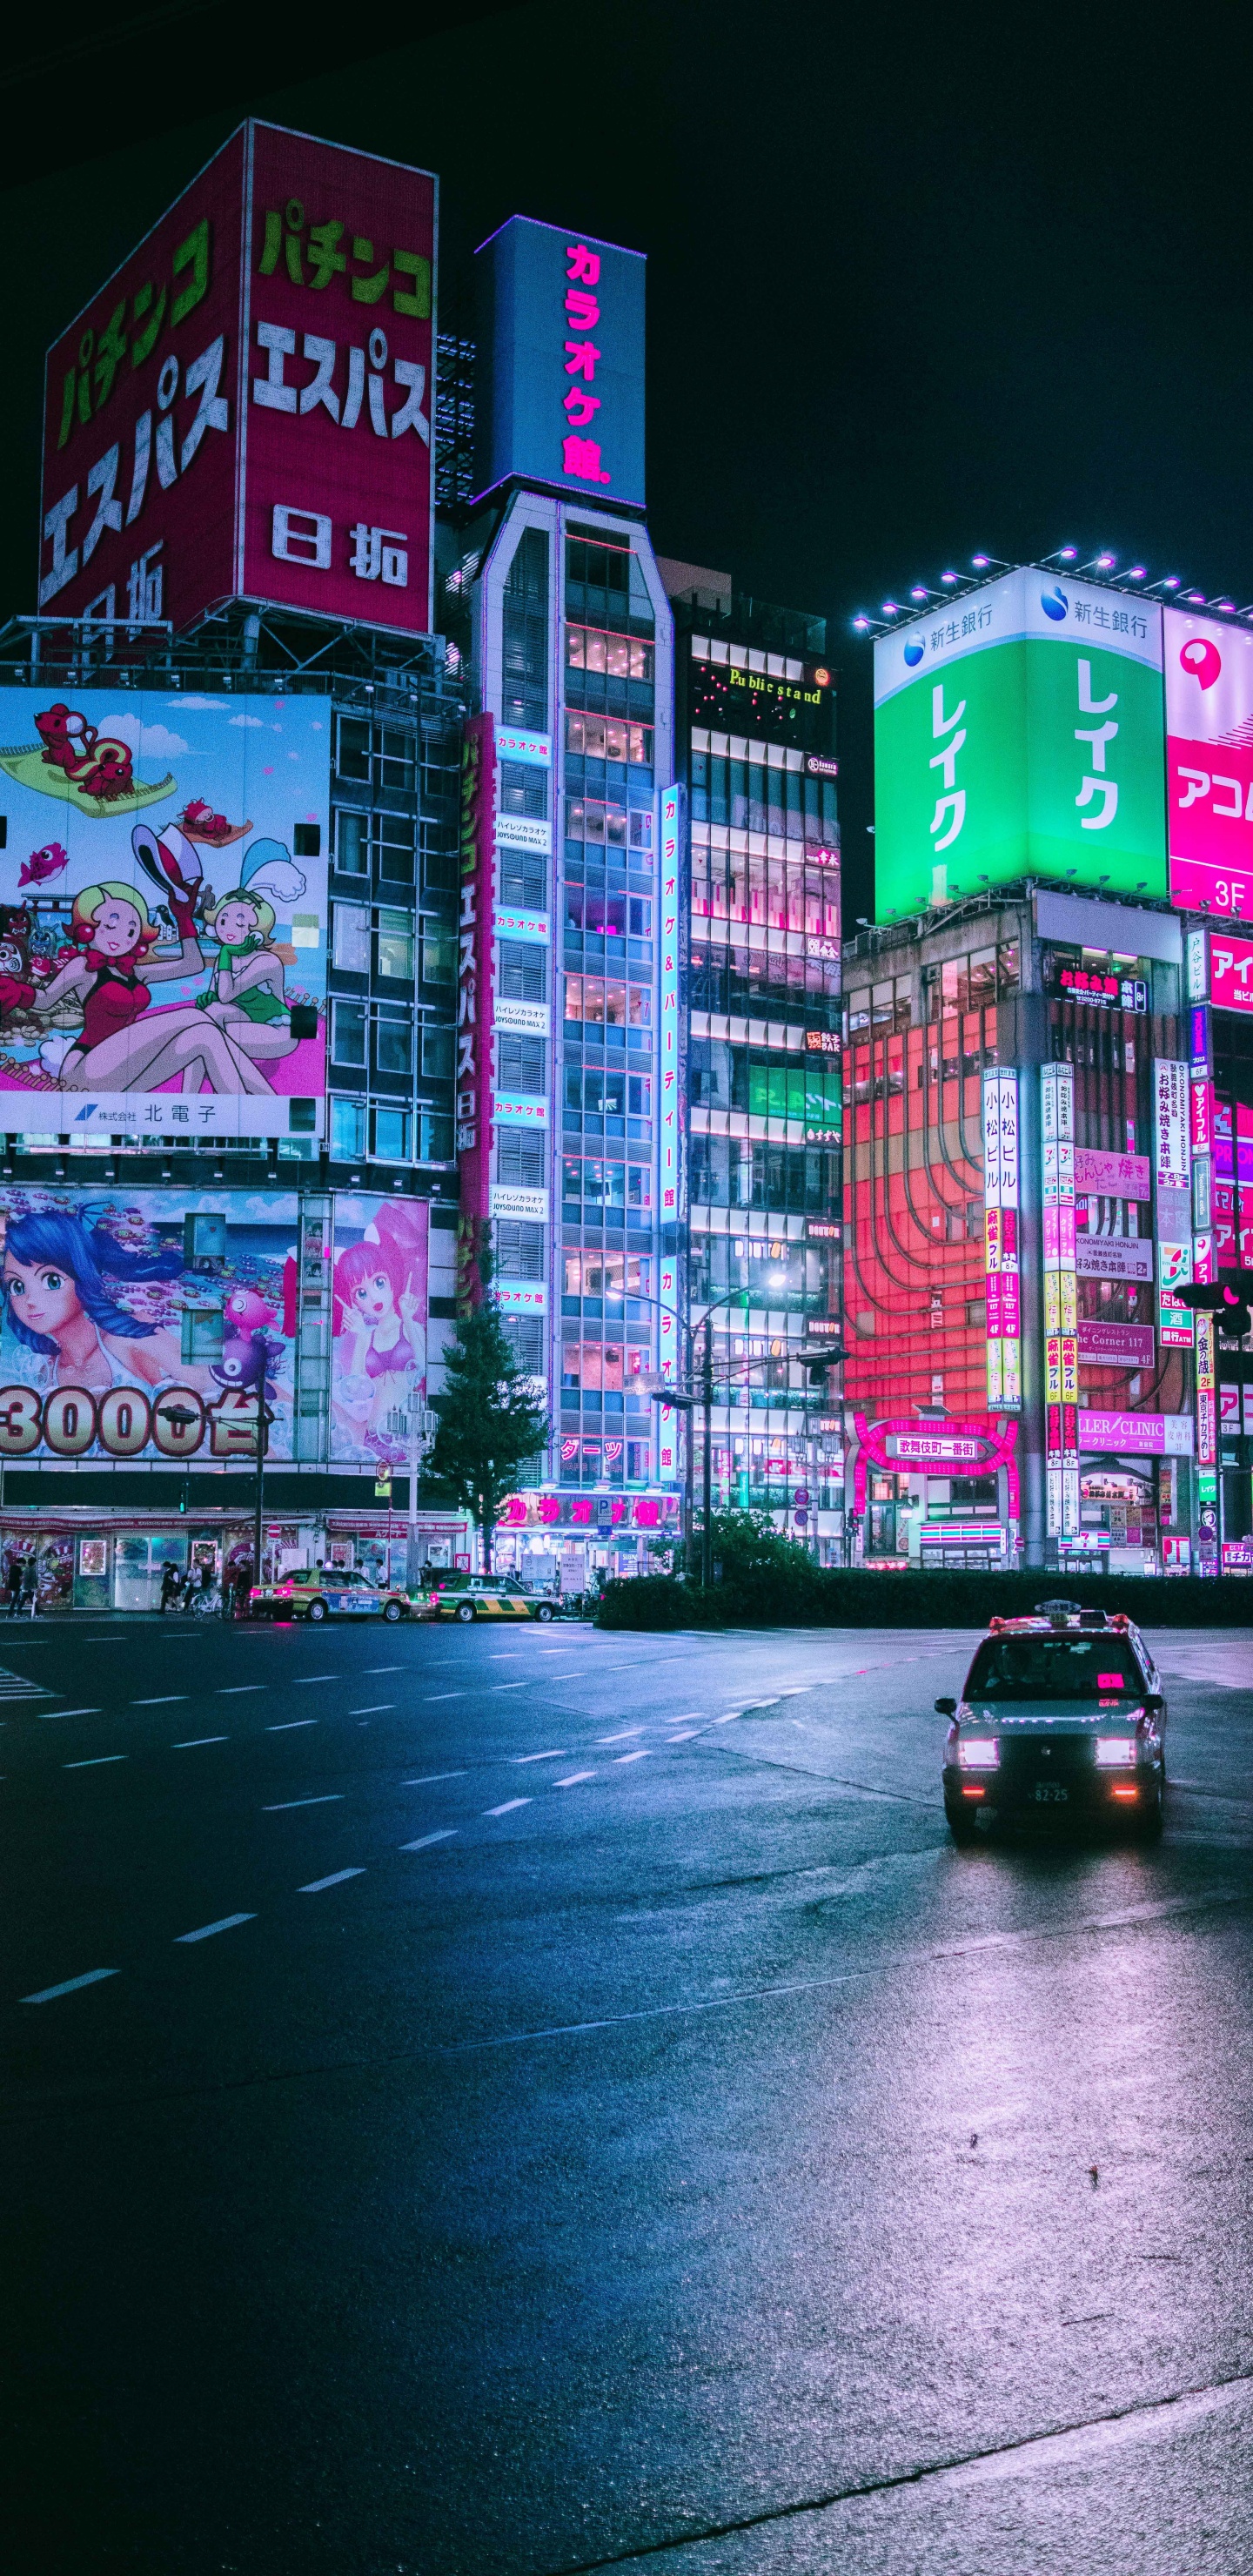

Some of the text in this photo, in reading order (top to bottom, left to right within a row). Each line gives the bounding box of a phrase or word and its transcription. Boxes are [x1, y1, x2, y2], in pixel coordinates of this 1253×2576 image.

[258, 198, 431, 320] パチンコ
[57, 218, 210, 452] パチンコ
[252, 320, 430, 449] エスパス
[39, 333, 228, 607] エスパス
[271, 503, 409, 587] 日拓
[930, 604, 994, 652] 新生銀行
[1075, 600, 1148, 639] 新生銀行
[730, 668, 821, 705] Public stand
[498, 737, 548, 755] カラオケ館
[1075, 658, 1119, 830] レイク
[929, 684, 967, 852] レイク
[460, 733, 479, 875] パチンコ
[498, 822, 547, 836] ハイレゾカラオケ
[497, 832, 526, 844] JOYSOUND
[528, 836, 542, 845] MAX
[1215, 881, 1245, 908] 3F
[497, 916, 547, 934] カラオケ館
[459, 882, 478, 1080] エスパス
[1136, 992, 1145, 1002] 8F
[821, 1043, 841, 1053] BAR
[98, 1104, 217, 1122] 株式会社 北電子
[495, 1103, 546, 1117] カラオケ館
[1196, 1097, 1206, 1143] アイフル
[986, 1091, 998, 1189] 小松ビル
[1002, 1091, 1015, 1188] 小松ビル
[1118, 1158, 1145, 1180] 焼き
[493, 1192, 544, 1204] ハイレゾカラオケ
[493, 1203, 524, 1213] JOYSOUND
[526, 1205, 539, 1214] MAX
[1076, 1238, 1115, 1247] KONOMIYAKI
[1076, 1258, 1127, 1273] 好み焼き本陣
[1198, 1264, 1208, 1284] アコ
[1170, 1311, 1183, 1325] 酒
[989, 1324, 999, 1334] 4F
[1005, 1324, 1016, 1334] 4F
[1091, 1334, 1125, 1346] Corner
[1129, 1338, 1143, 1348] 117
[1141, 1354, 1151, 1365] 4F
[1198, 1337, 1209, 1375] 金の蔵
[1201, 1378, 1211, 1387] 2F
[1049, 1392, 1058, 1401] 6F
[1065, 1392, 1075, 1400] 6F
[1078, 1418, 1164, 1437] LLER CLINIC
[1199, 1394, 1209, 1459] 東京チカラめし
[1223, 1424, 1234, 1432] 3F
[560, 1439, 623, 1461] ダーツ
[899, 1439, 974, 1457] 歌舞伎町一番街
[1092, 1437, 1127, 1446] クリニック
[1175, 1443, 1183, 1452] 3F
[1066, 1459, 1075, 1467] 8F
[600, 1499, 609, 1515] P
